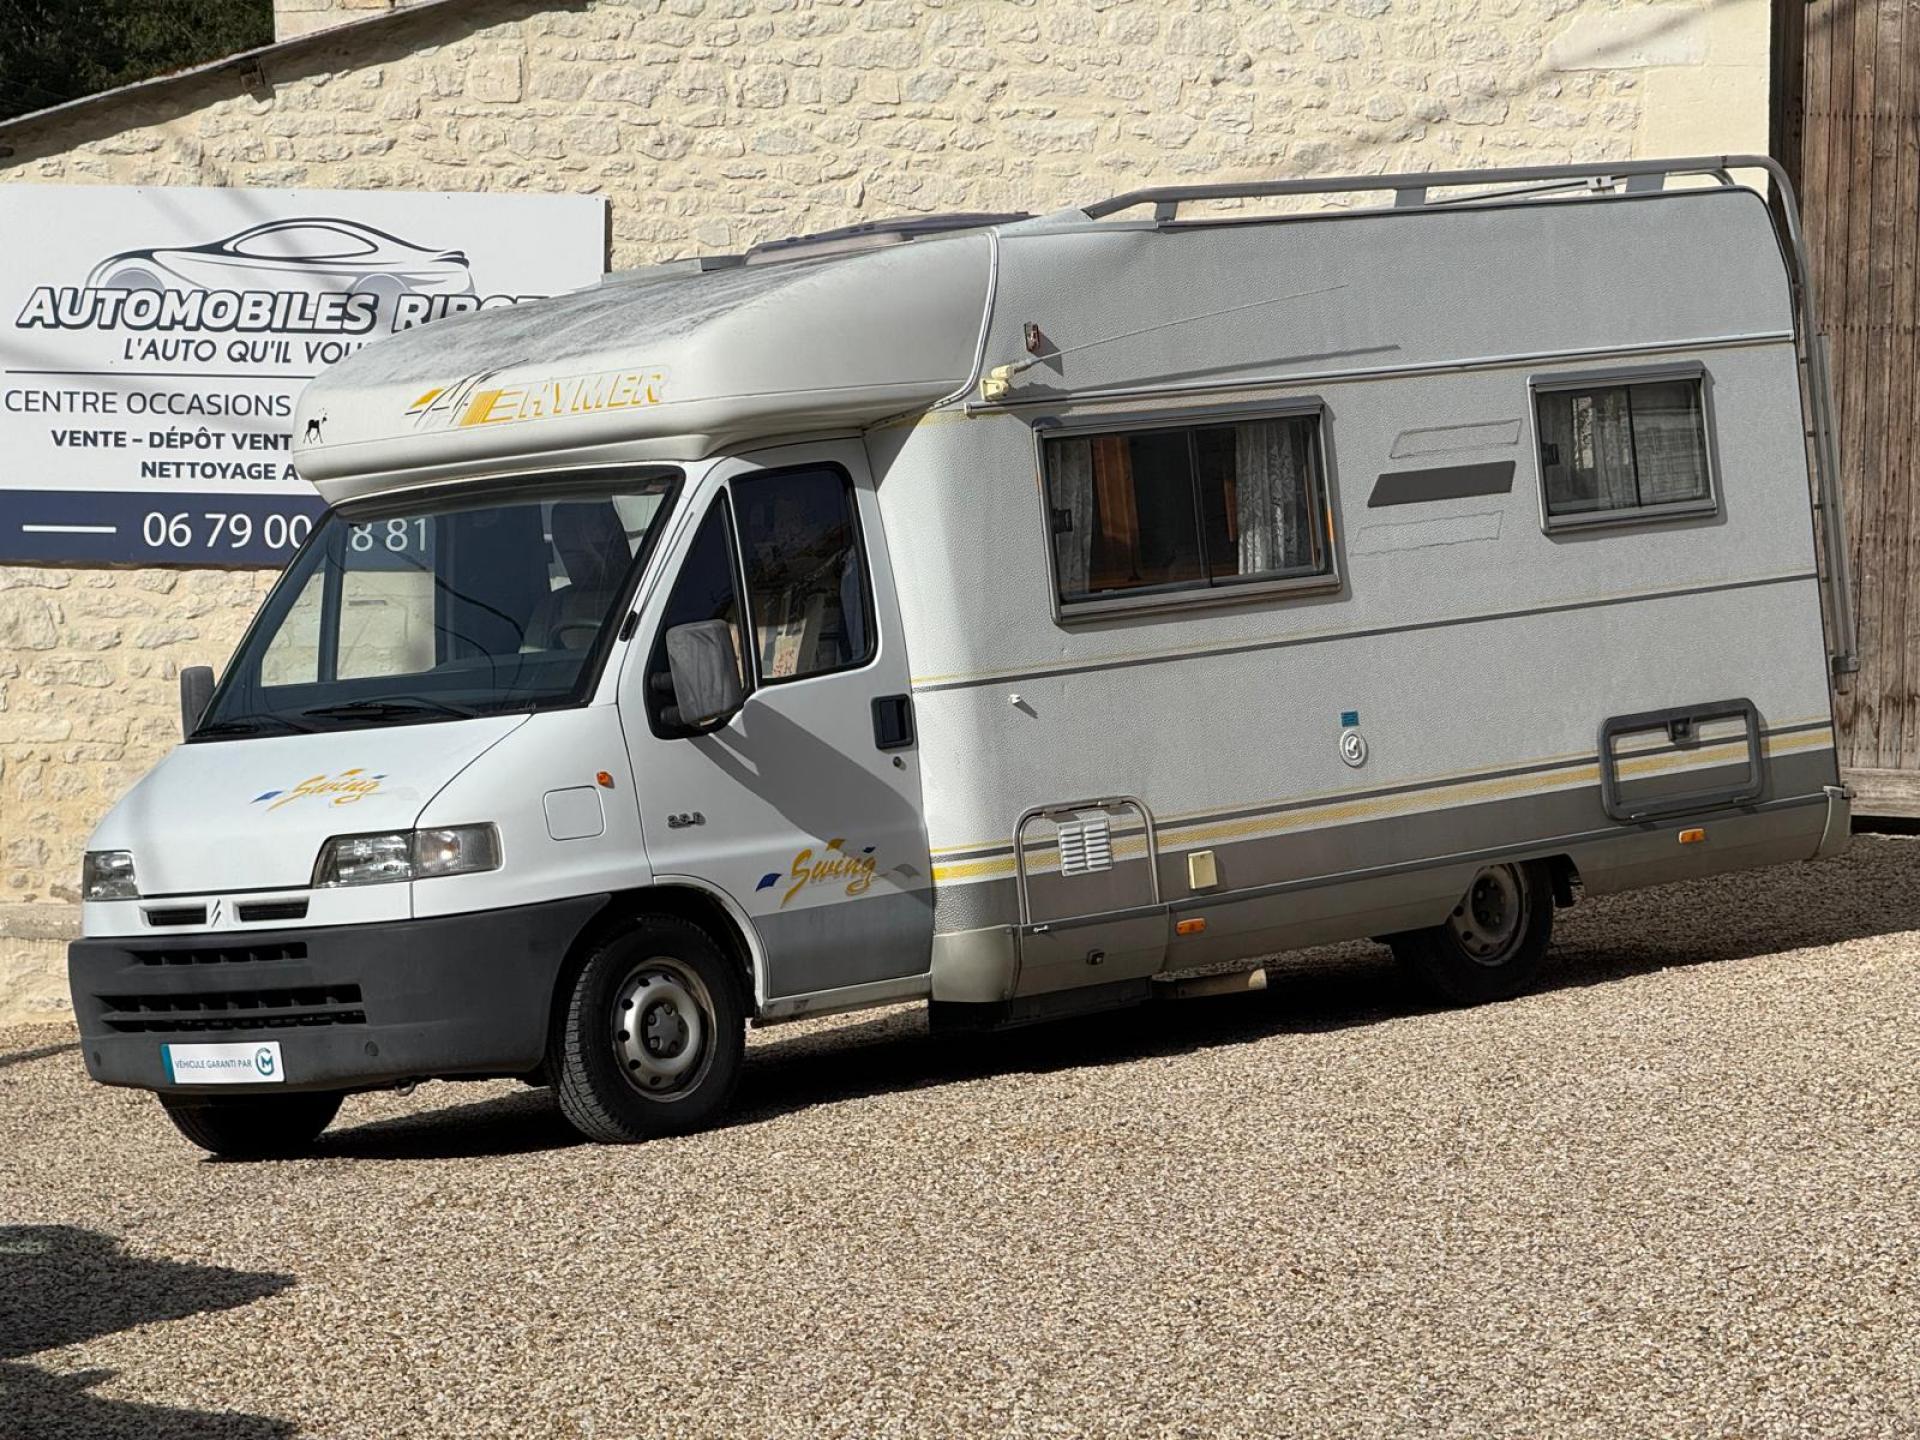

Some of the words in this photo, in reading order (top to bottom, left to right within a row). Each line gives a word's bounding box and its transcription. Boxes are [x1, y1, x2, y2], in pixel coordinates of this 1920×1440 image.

[16, 287, 378, 334] AUTOMOBILES
[124, 338, 216, 362] L'AUTO
[227, 340, 291, 363] QU'IL
[304, 341, 372, 365] VO
[5, 390, 118, 413] CENTRE
[126, 392, 291, 416] OCCASIONS
[51, 430, 127, 448] VENTE
[149, 426, 225, 450] DÉPÔT
[141, 461, 277, 481] NETTOYAGE
[143, 512, 192, 547] 06
[204, 513, 252, 548] 79
[263, 514, 312, 549] 00
[385, 518, 427, 552] 81
[238, 1059, 252, 1068] PAR
